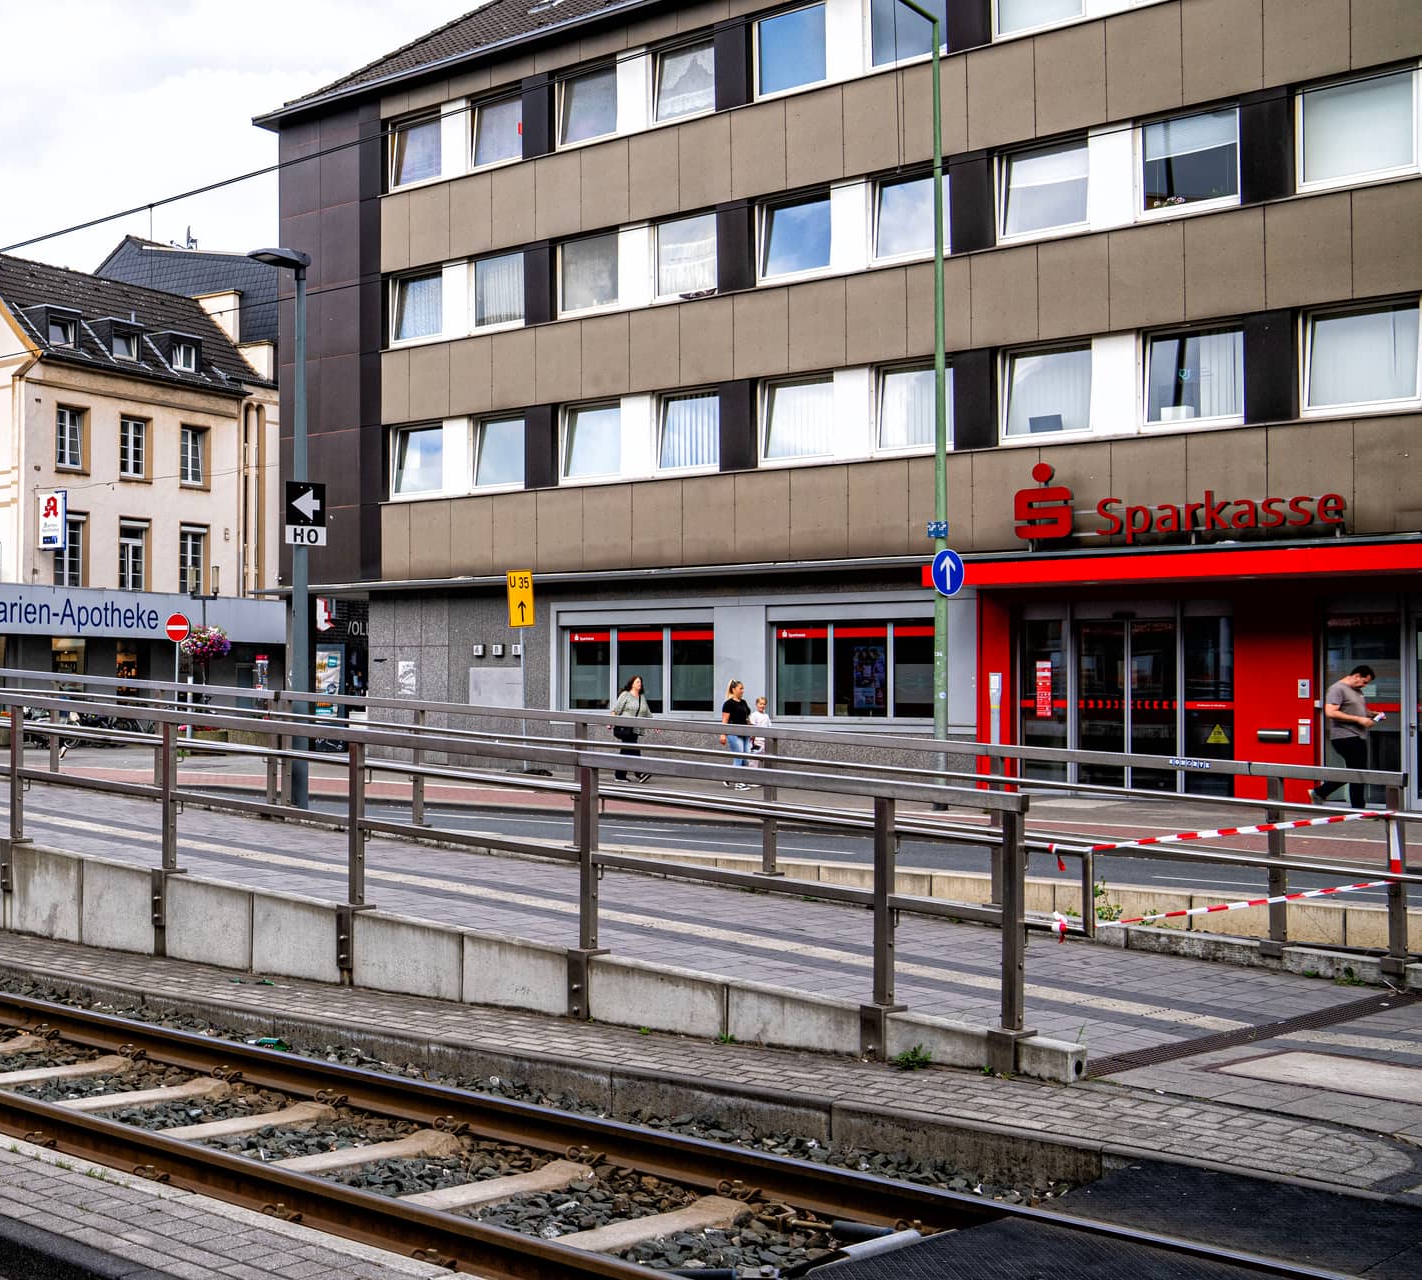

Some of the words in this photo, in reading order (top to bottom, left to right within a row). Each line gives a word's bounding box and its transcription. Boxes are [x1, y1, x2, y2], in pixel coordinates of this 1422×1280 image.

[1096, 490, 1346, 544] Sparkasse
[293, 528, 319, 544] HO
[509, 576, 516, 588] U
[519, 576, 530, 589] 35
